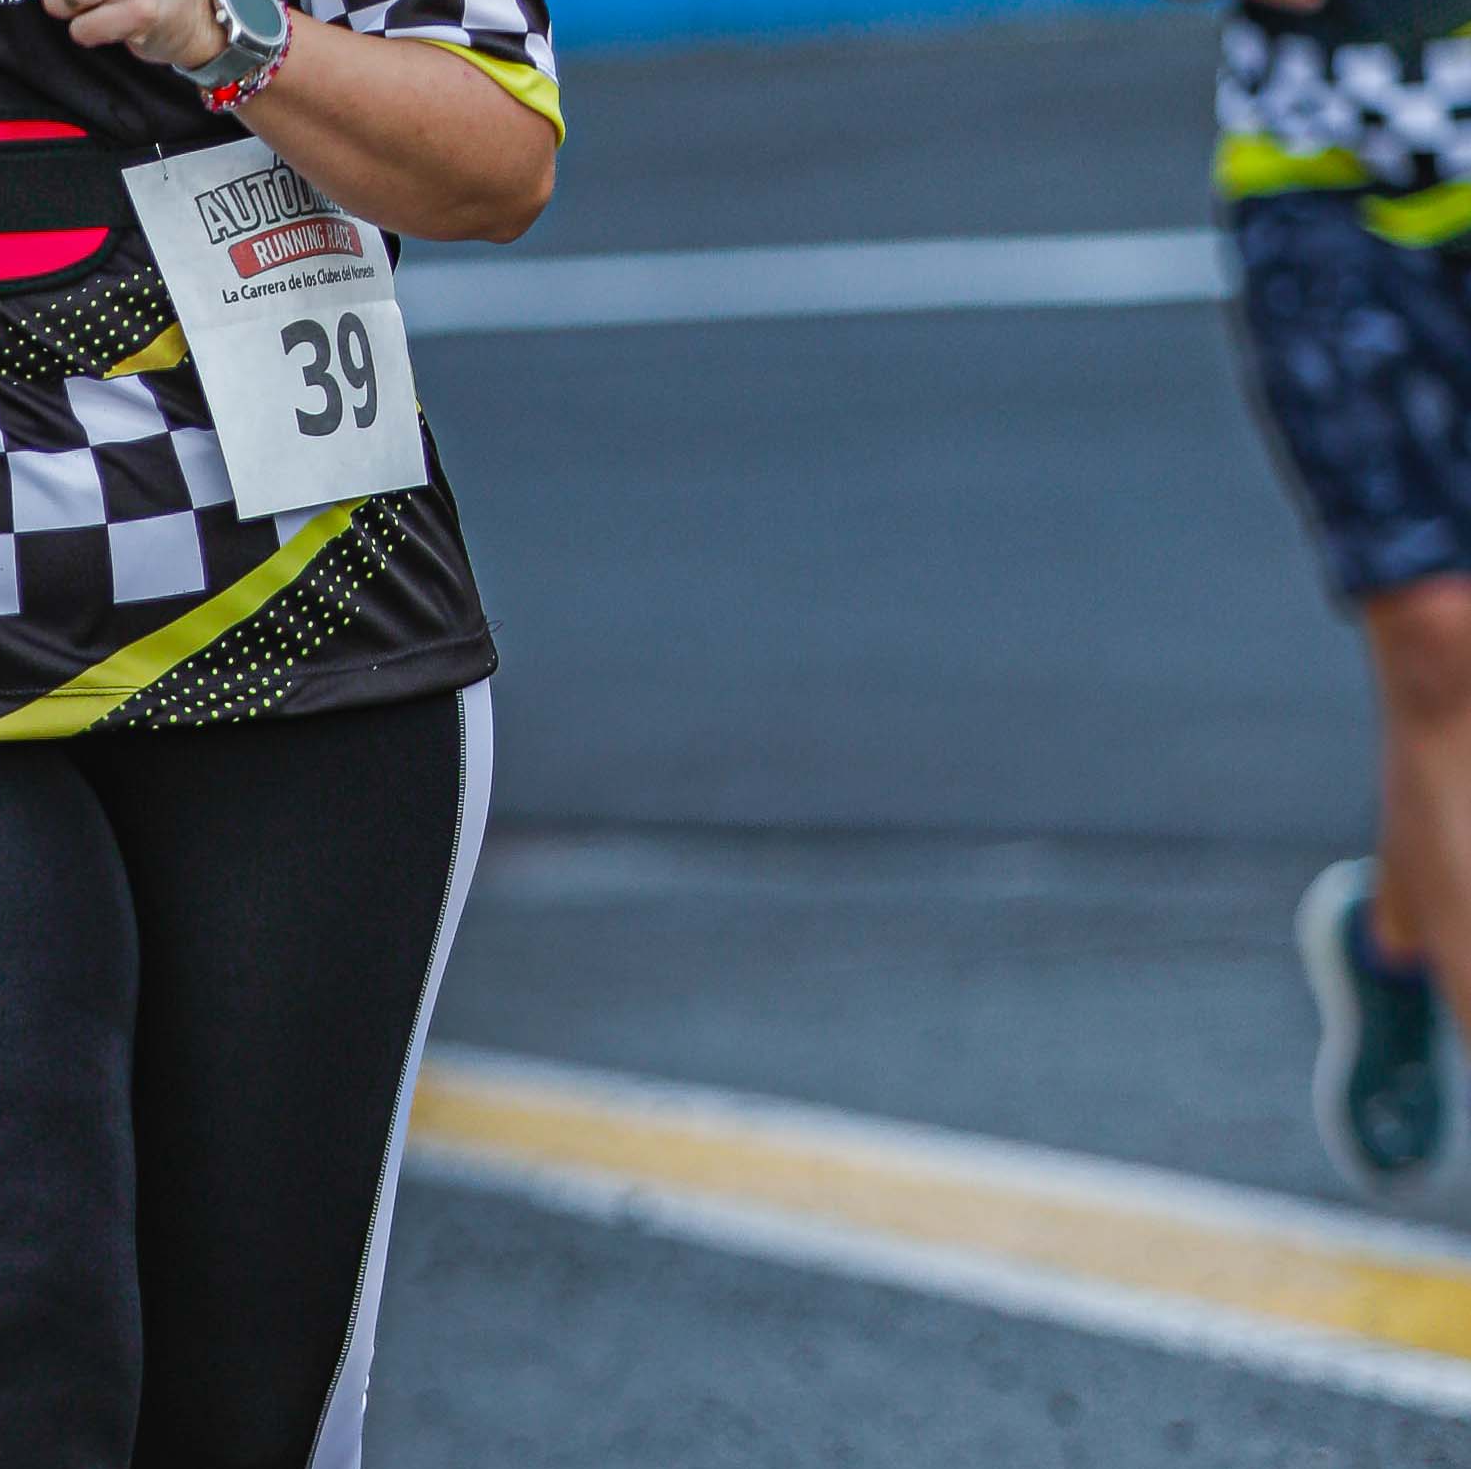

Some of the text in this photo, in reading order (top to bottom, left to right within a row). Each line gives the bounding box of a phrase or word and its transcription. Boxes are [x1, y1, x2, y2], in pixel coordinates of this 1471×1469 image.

[251, 223, 354, 268] RUNNING RACE
[222, 288, 239, 304] La
[241, 281, 287, 300] Carrera
[288, 273, 302, 290] de
[302, 271, 317, 288] los
[317, 267, 341, 284] Clubes
[341, 263, 352, 281] del
[280, 311, 378, 437] 39
